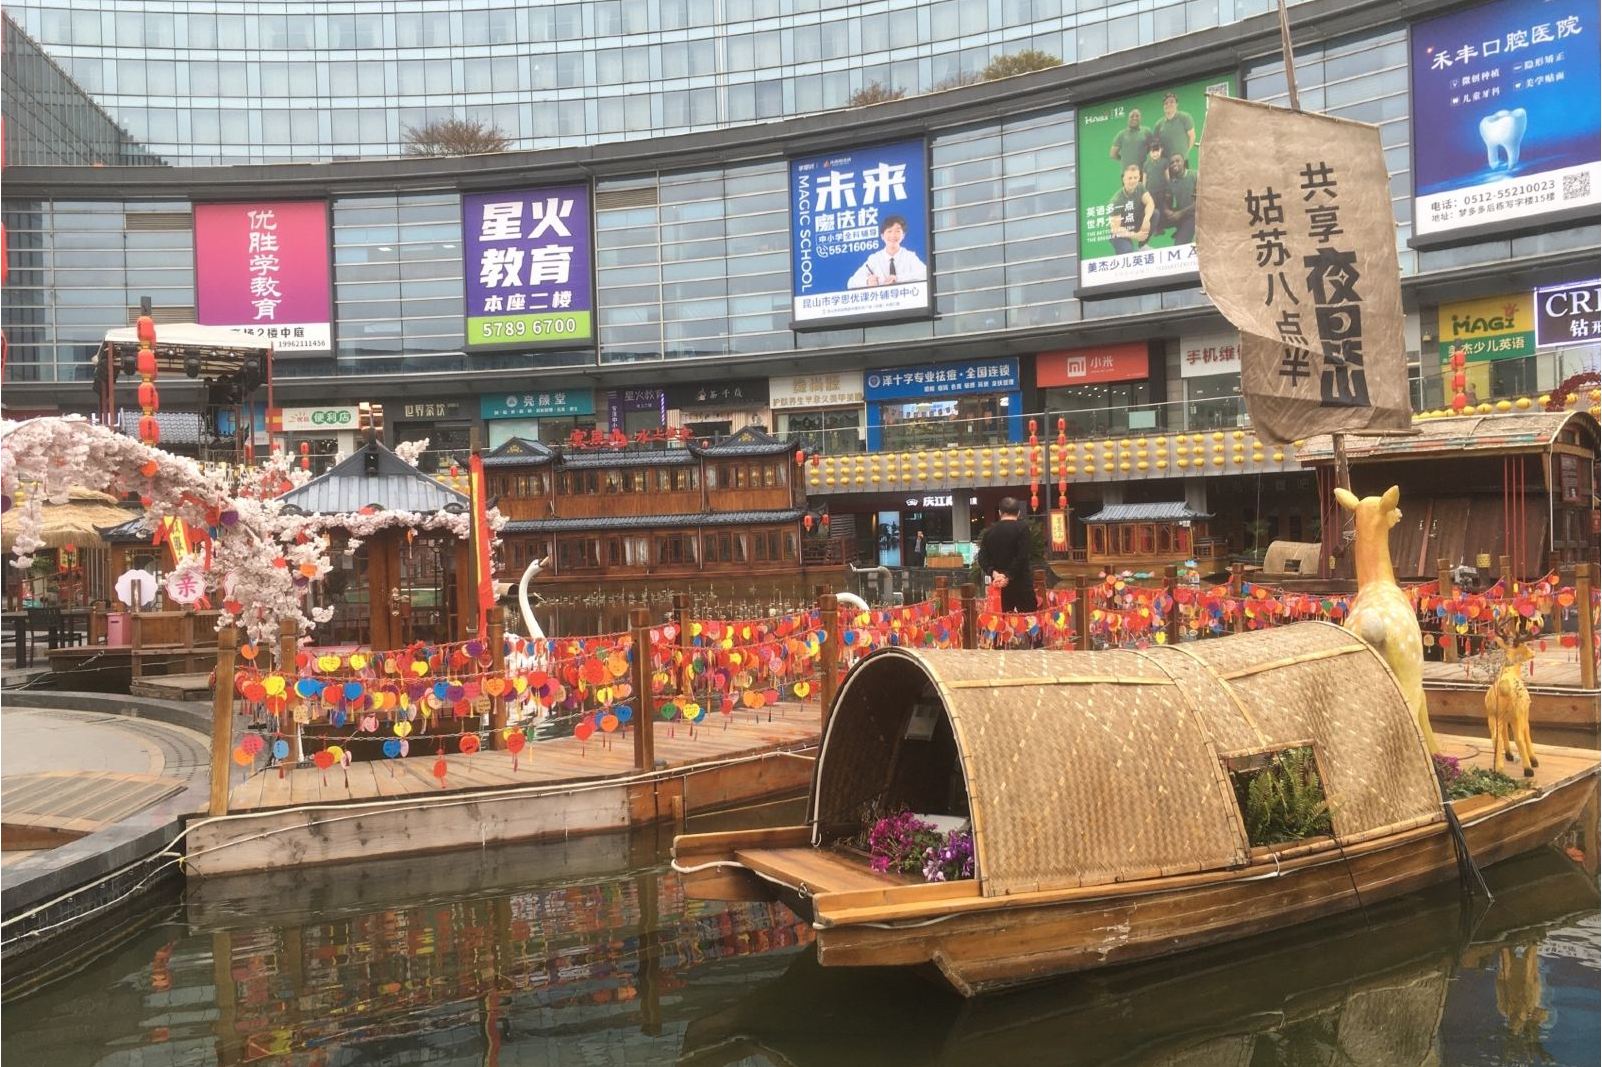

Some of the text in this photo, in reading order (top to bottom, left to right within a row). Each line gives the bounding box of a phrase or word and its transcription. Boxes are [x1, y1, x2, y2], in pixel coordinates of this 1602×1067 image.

[1431, 15, 1583, 71] 禾丰口腔医院
[815, 162, 908, 212] 未来
[1464, 181, 1556, 206] 0512-55210023
[479, 197, 575, 242] 星火
[798, 175, 813, 293] MAGIC SCHOOL
[829, 240, 879, 255] 55216066
[246, 209, 283, 321] 优胜学教育
[479, 243, 574, 288] 教育
[1087, 252, 1155, 274] 美杰少儿英语
[1244, 187, 1311, 387] 姑苏八点半
[484, 291, 572, 312] 本座二楼
[483, 317, 577, 338] 5789 6700
[1089, 355, 1114, 368] 小米
[1186, 344, 1241, 366] 手机维
[313, 411, 350, 423] 便利店
[175, 574, 199, 598] 亲
